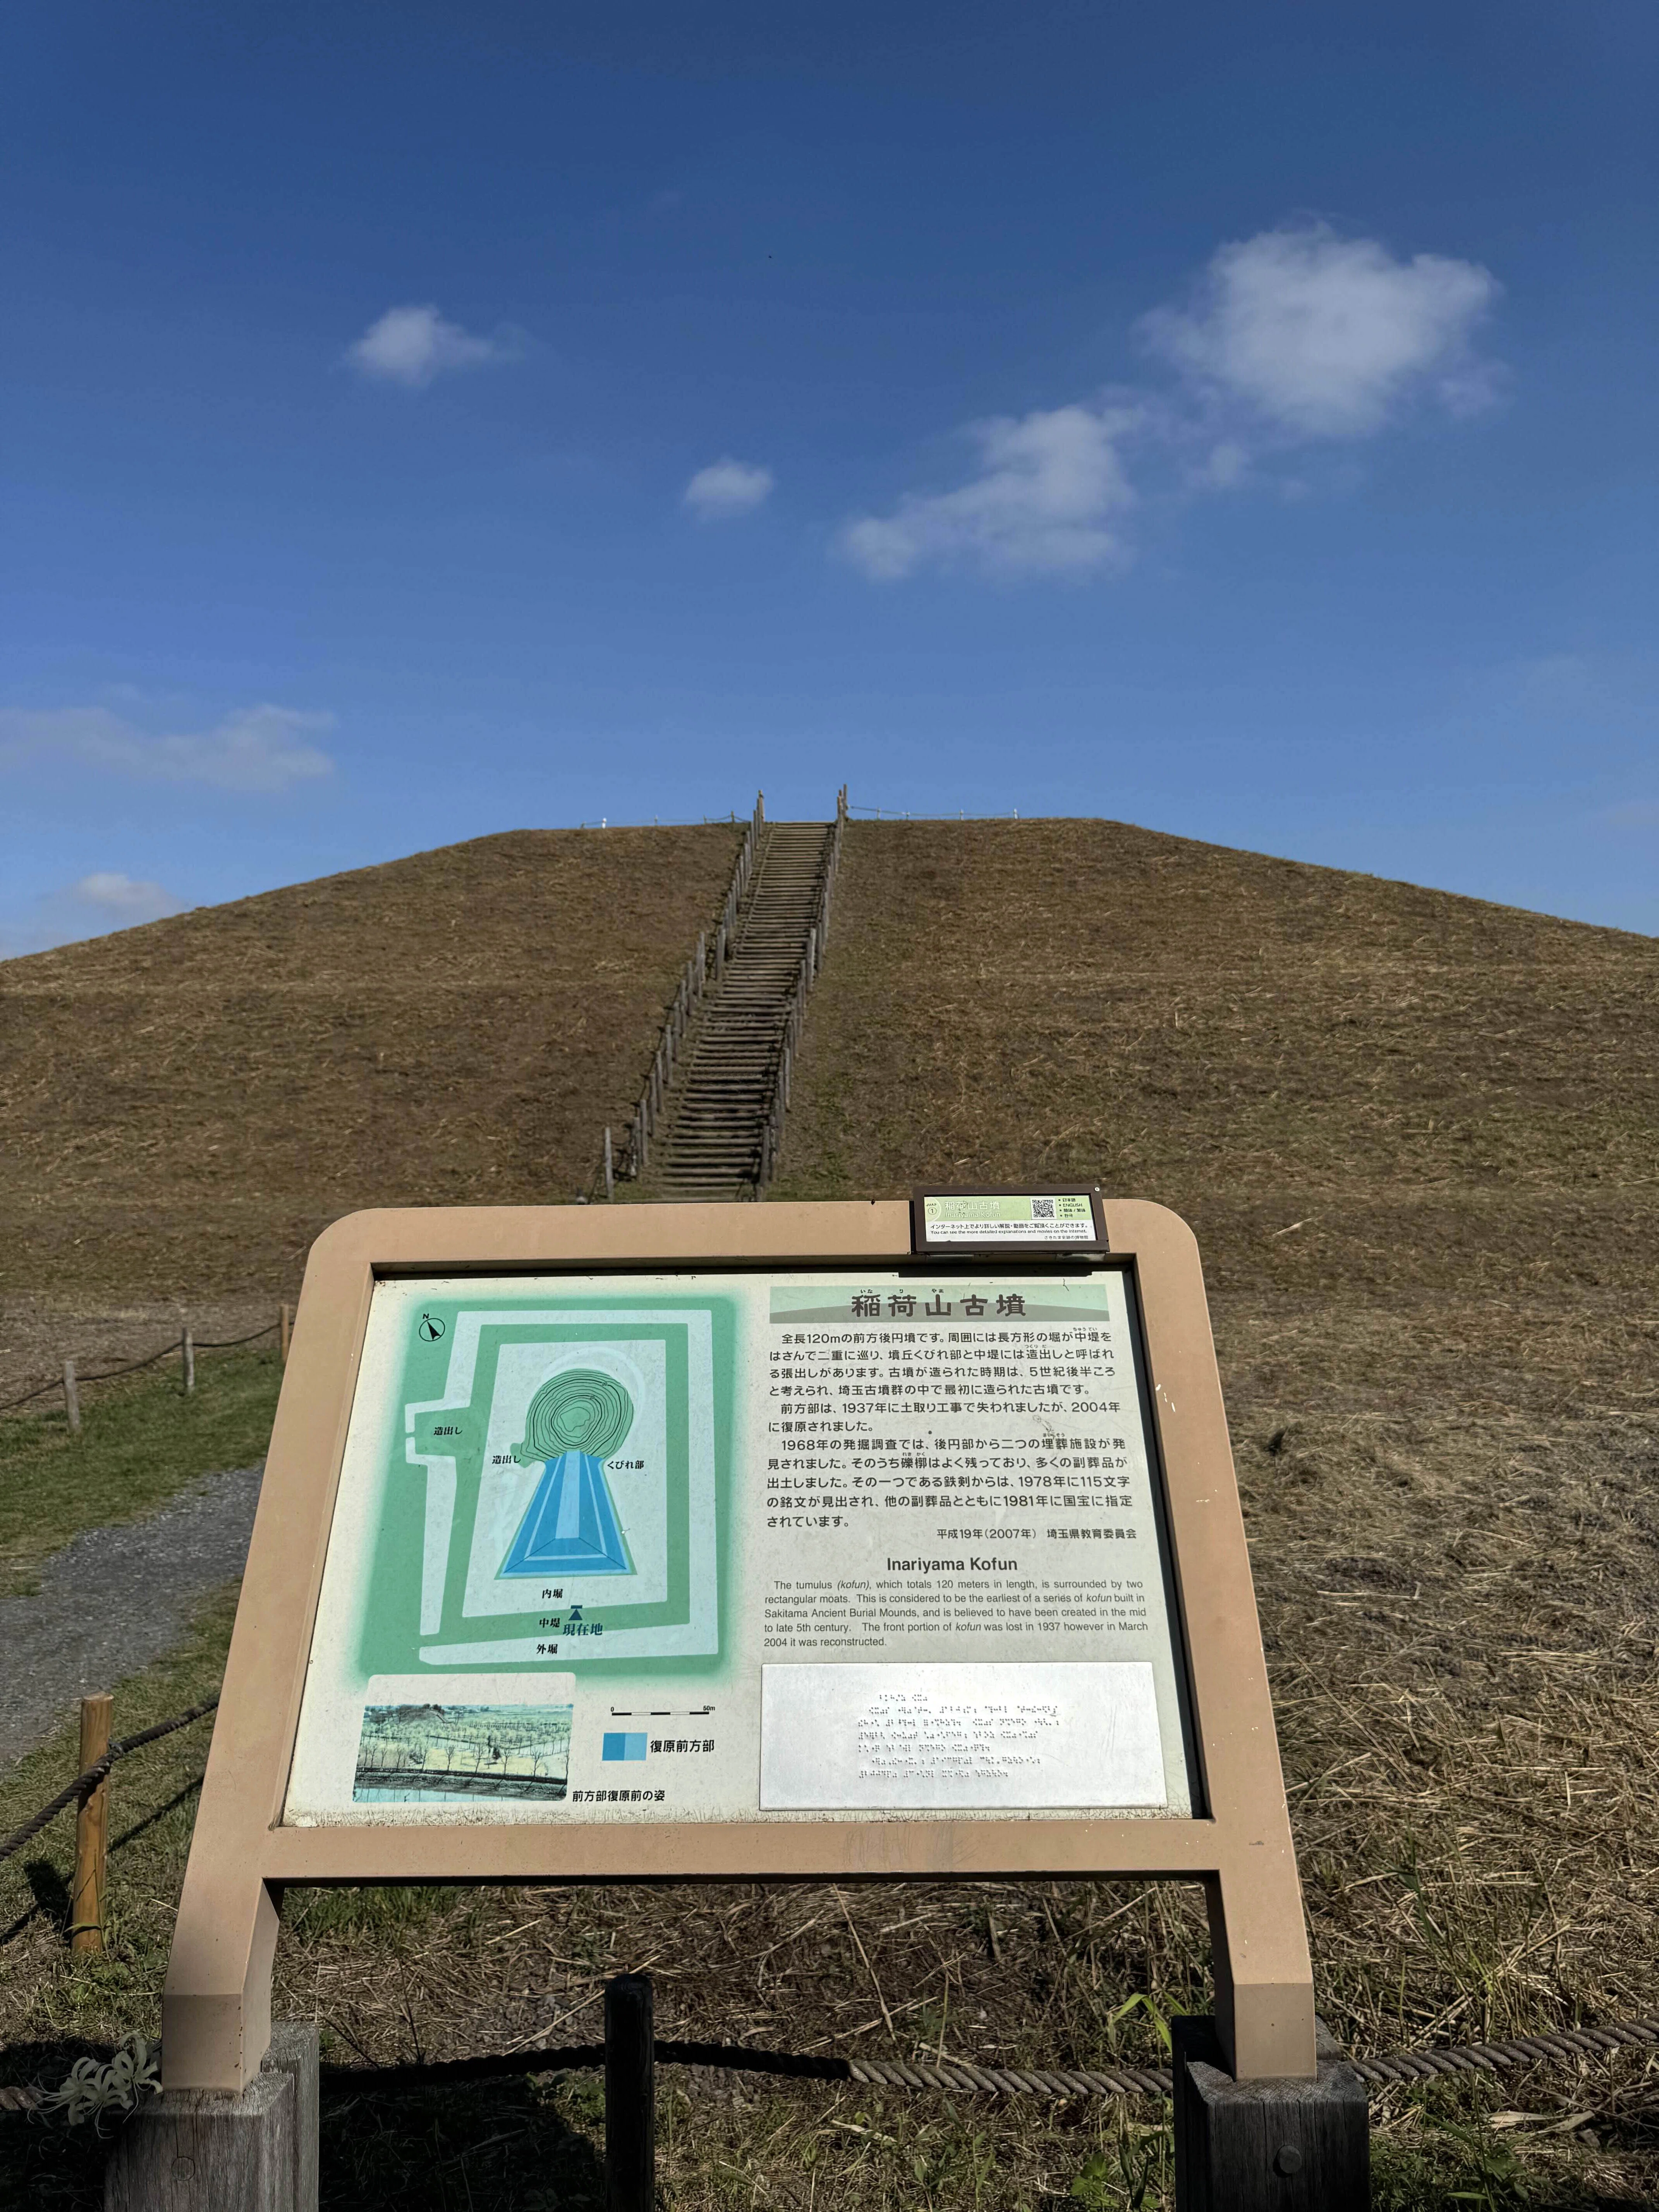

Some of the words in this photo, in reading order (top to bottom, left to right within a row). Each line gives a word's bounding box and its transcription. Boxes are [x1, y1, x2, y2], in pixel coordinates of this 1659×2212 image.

[945, 1201, 1000, 1210] 稲荷山古墳
[851, 1293, 1026, 1317] 稲荷山古墳
[781, 1331, 1111, 1344] 全長120mの前方後円墳です。周囲には長方形の堀が中堤を
[769, 1348, 1115, 1361] はさんで二重に巡り、墳丘くびれ部と中堤には造出しと呼ばれ
[769, 1383, 1089, 1396] と考えられ、埼玉古墳群の中で最初に造られた古墳です。
[780, 1401, 1121, 1415] 前方部は、1937年に土取り工事で失われましたが、2004年
[433, 1426, 463, 1436] 造出し
[768, 1420, 873, 1433] に復原されました。
[781, 1437, 1126, 1451] 1968年の発掘調査では、後円部から二つの埋葬施設が発
[491, 1455, 521, 1464] 造出し
[607, 1460, 644, 1470] くびれ部
[767, 1475, 1130, 1489] 出土しました。その一つである鉄剣からは、1978年に115文字
[767, 1494, 1133, 1509] の銘文が見出され、他の副葬品とともに1981年に国宝に指定
[767, 1515, 849, 1528] されています。
[1046, 1528, 1137, 1539] 埼玉県教育委員会
[887, 1557, 965, 1574] Inariyama
[970, 1557, 1018, 1571] Kofun
[773, 1580, 792, 1590] The
[796, 1580, 833, 1590] tumulus
[837, 1580, 871, 1591] (kofun),
[876, 1580, 903, 1589] which
[907, 1580, 932, 1589] totals
[936, 1580, 953, 1589] 120
[958, 1580, 990, 1589] meters
[993, 1580, 1002, 1589] in
[1006, 1580, 1037, 1590] length,
[1042, 1580, 1050, 1589] is
[1054, 1580, 1107, 1589] surrounded
[1111, 1580, 1122, 1590] by
[1126, 1580, 1143, 1589] two
[542, 1588, 563, 1599] 内堀
[765, 1594, 817, 1606] rectangular
[819, 1594, 851, 1604] moats.
[856, 1594, 876, 1603] This
[879, 1594, 887, 1603] is
[889, 1594, 940, 1603] considered
[943, 1594, 952, 1603] to
[954, 1594, 966, 1602] be
[969, 1594, 984, 1602] the
[986, 1593, 1020, 1603] earliest
[1023, 1593, 1032, 1602] of
[1043, 1594, 1072, 1602] series
[1074, 1593, 1083, 1602] of
[1086, 1593, 1112, 1602] kofun
[1114, 1593, 1134, 1602] built
[1136, 1593, 1145, 1602] in
[764, 1609, 808, 1618] Sakitama
[811, 1608, 846, 1618] Ancient
[849, 1608, 876, 1617] Burial
[879, 1608, 919, 1618] Mounds,
[922, 1607, 940, 1617] and
[943, 1607, 951, 1617] is
[954, 1607, 994, 1617] believed
[996, 1608, 1006, 1617] to
[1008, 1607, 1032, 1617] have
[1034, 1607, 1058, 1617] been
[1061, 1607, 1097, 1617] created
[1099, 1607, 1108, 1616] in
[1111, 1607, 1127, 1616] the
[1129, 1607, 1147, 1616] mid
[539, 1617, 560, 1628] 中堤
[764, 1624, 773, 1633] to
[776, 1623, 793, 1632] late
[796, 1623, 811, 1632] 5th
[814, 1623, 851, 1634] century.
[861, 1622, 880, 1632] The
[883, 1622, 905, 1632] front
[907, 1622, 940, 1633] portion
[943, 1622, 952, 1631] of
[955, 1622, 981, 1632] kofun
[1006, 1622, 1023, 1631] lost
[1025, 1622, 1034, 1631] in
[1037, 1622, 1060, 1631] 1937
[1063, 1622, 1104, 1631] however
[1107, 1621, 1116, 1631] in
[1118, 1621, 1148, 1631] March
[563, 1623, 603, 1636] 現在地
[764, 1638, 788, 1647] 2004
[790, 1637, 796, 1647] it
[820, 1637, 887, 1646] reconstructed.
[536, 1644, 558, 1654] 外堀
[650, 1740, 714, 1753] 復原前方部
[572, 1790, 665, 1802] 前方部復原前の姿
